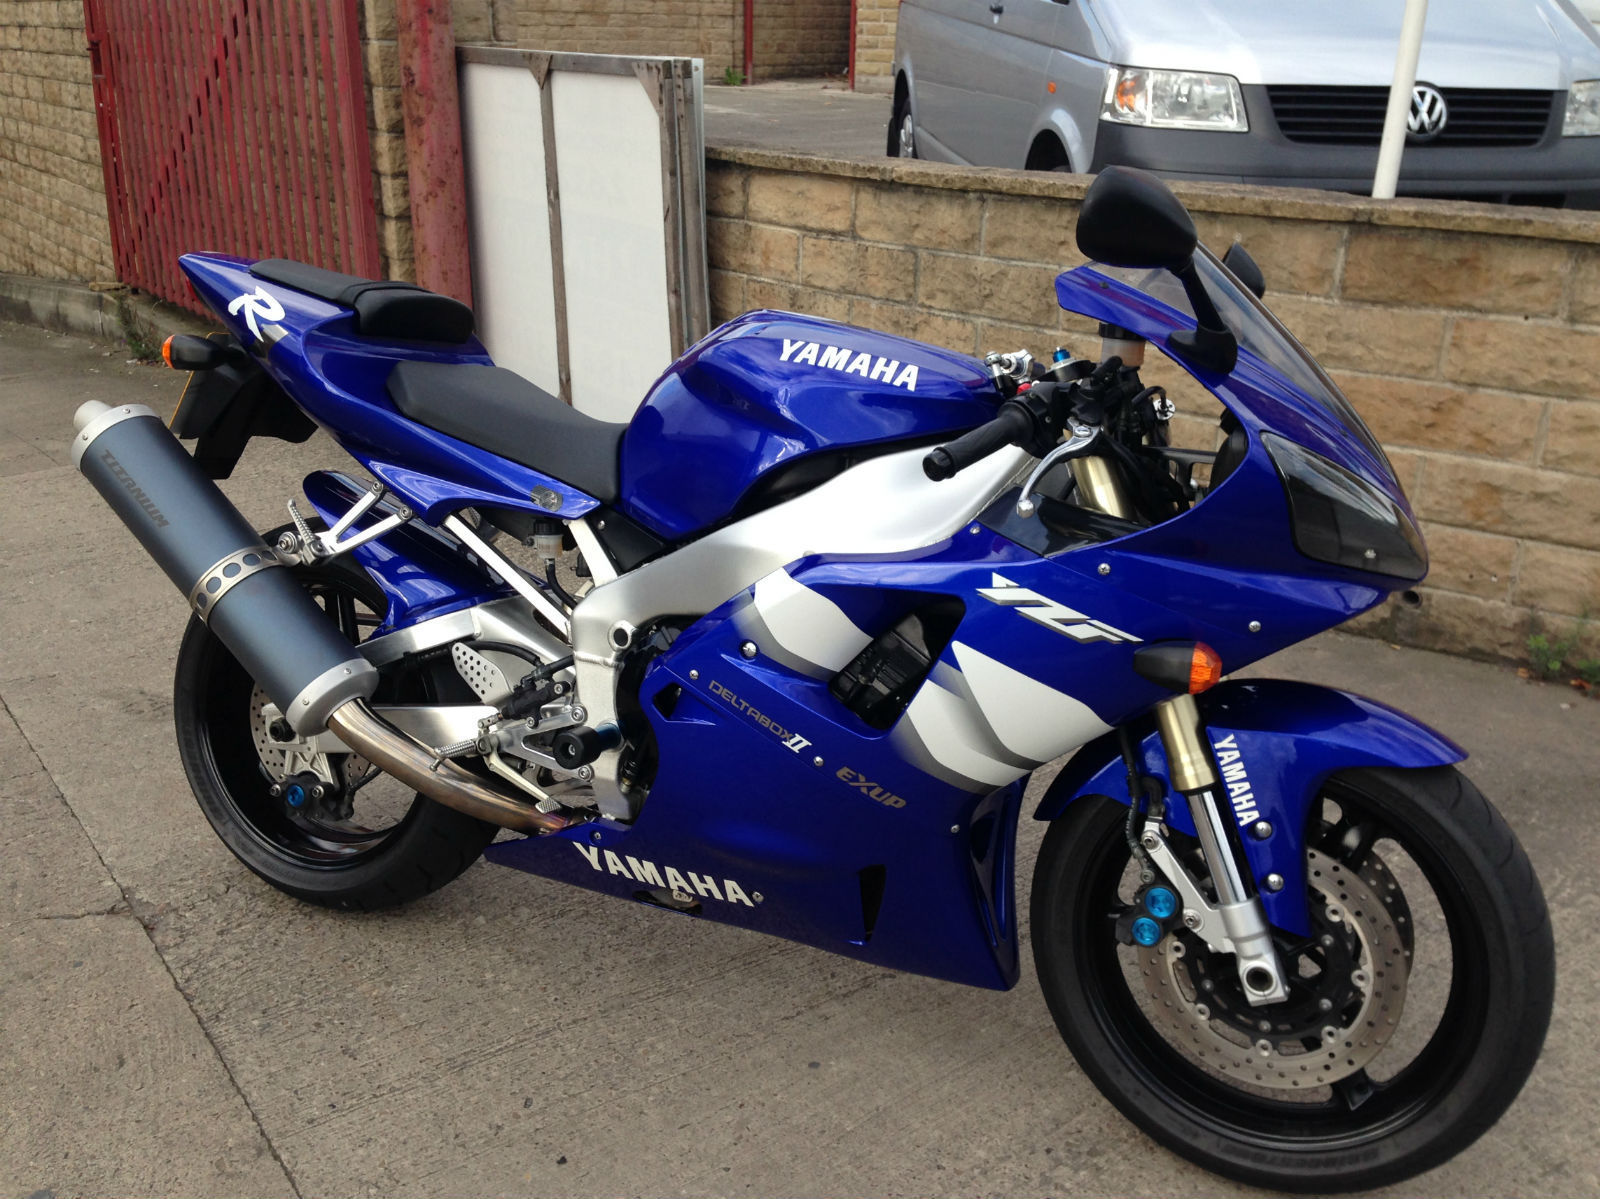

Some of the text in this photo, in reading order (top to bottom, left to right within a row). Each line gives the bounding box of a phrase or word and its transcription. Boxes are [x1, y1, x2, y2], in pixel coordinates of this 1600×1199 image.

[779, 338, 919, 392] YAMAHA
[101, 449, 170, 528] TITANIUM
[836, 766, 907, 809] EXUP
[1214, 733, 1260, 827] YAMAHA
[573, 841, 754, 908] YAMAHA
